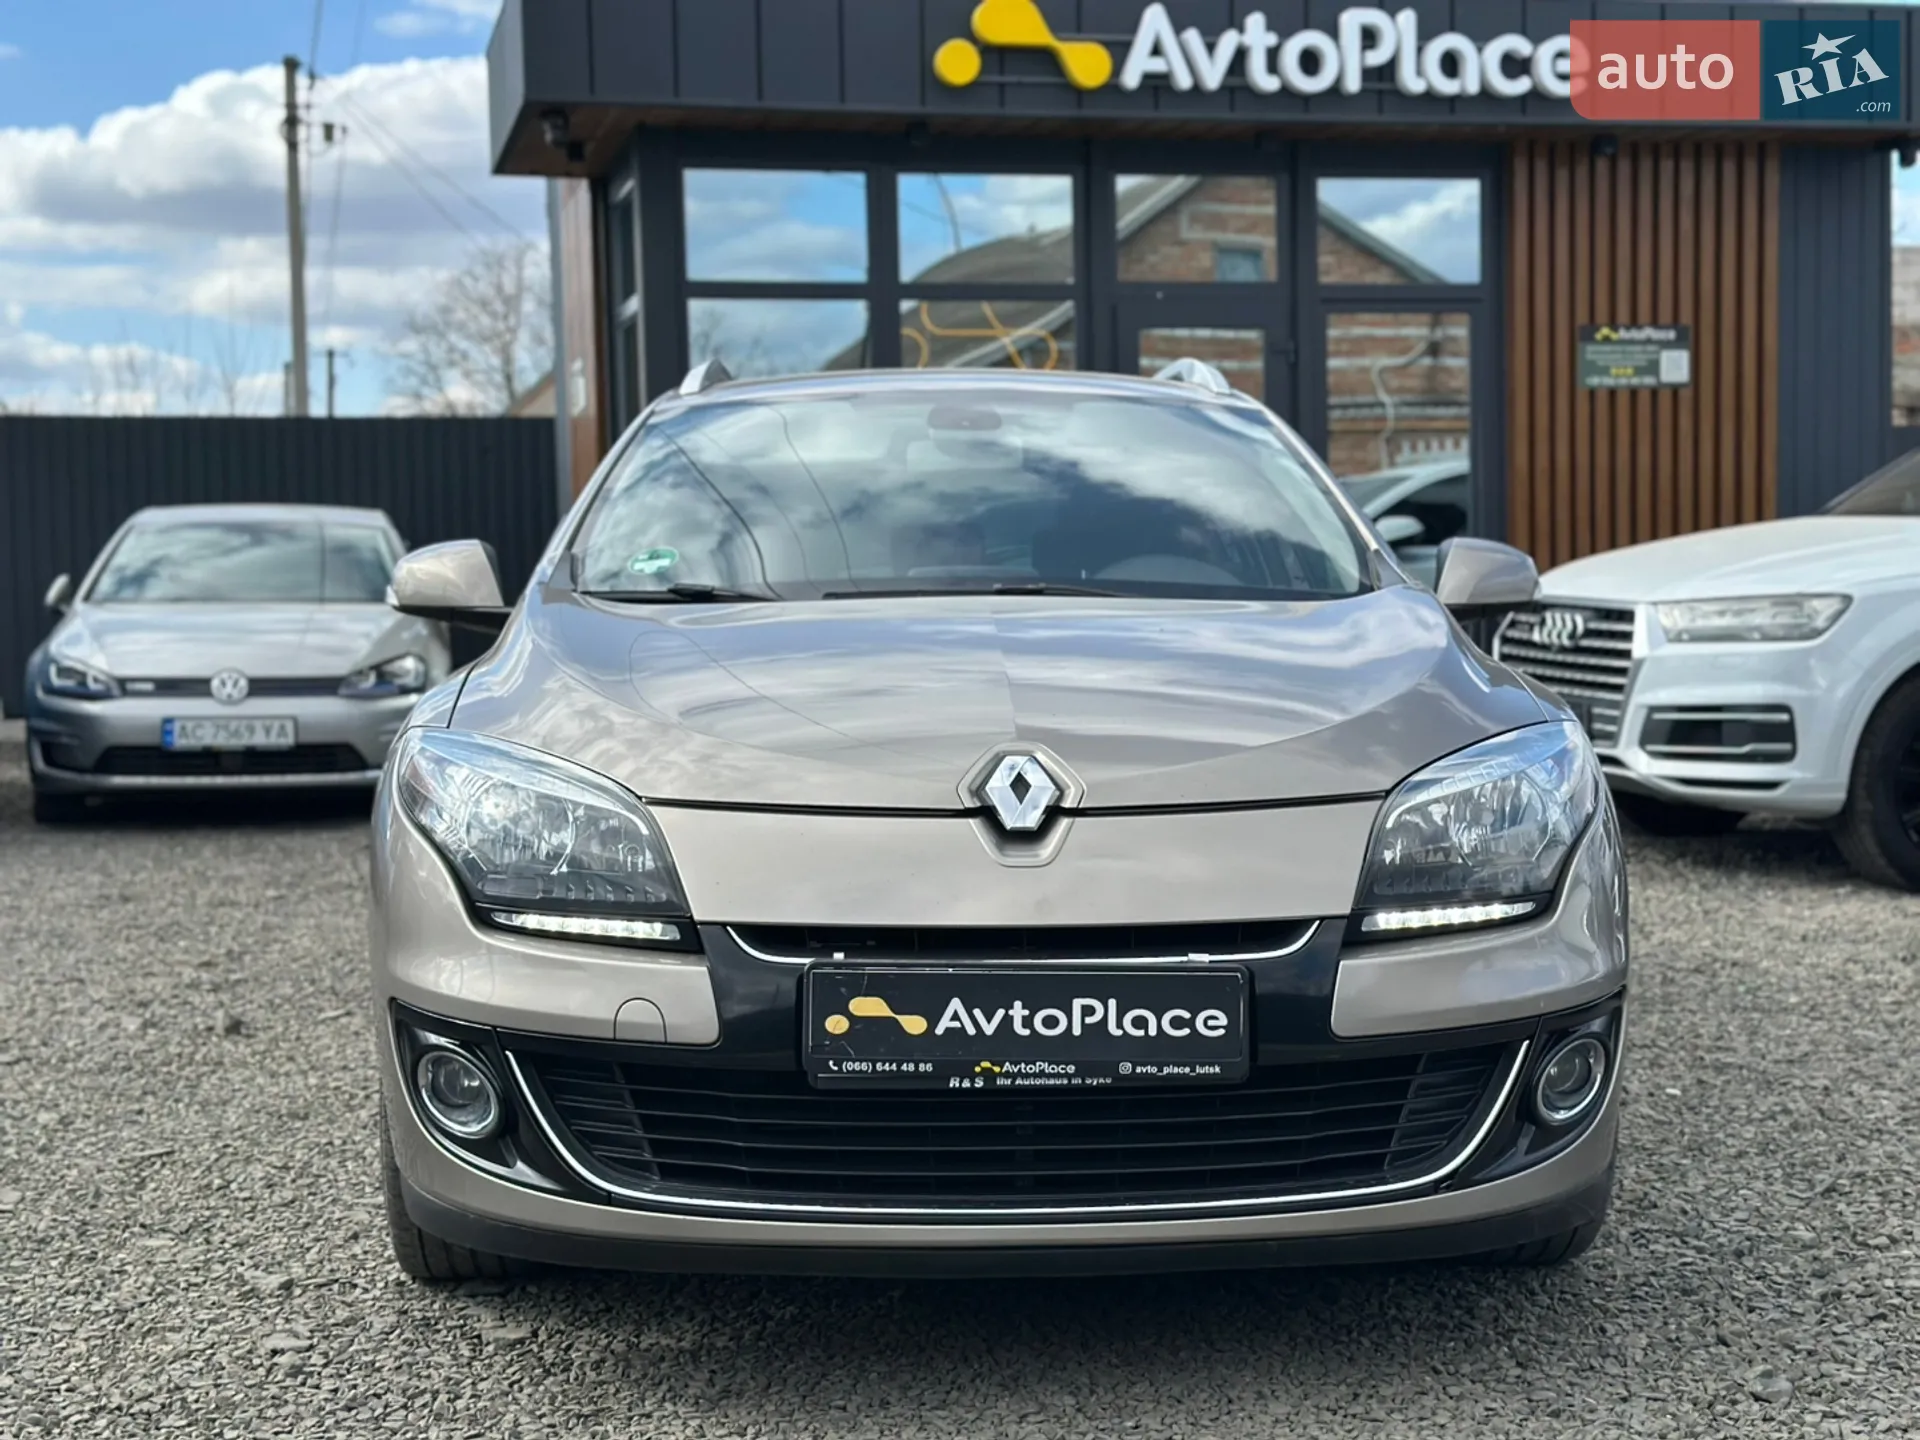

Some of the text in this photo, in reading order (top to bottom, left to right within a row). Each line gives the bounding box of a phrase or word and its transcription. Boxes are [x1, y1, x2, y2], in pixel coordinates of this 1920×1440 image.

[1119, 2, 1590, 98] AvtoPlace
[178, 722, 205, 741] AC
[934, 997, 1228, 1037] AvtoPlace
[842, 1061, 934, 1073] (066) 644 48 86
[1001, 1061, 1076, 1074] AvtoPlace
[1135, 1064, 1221, 1076] avto_place_lutsk
